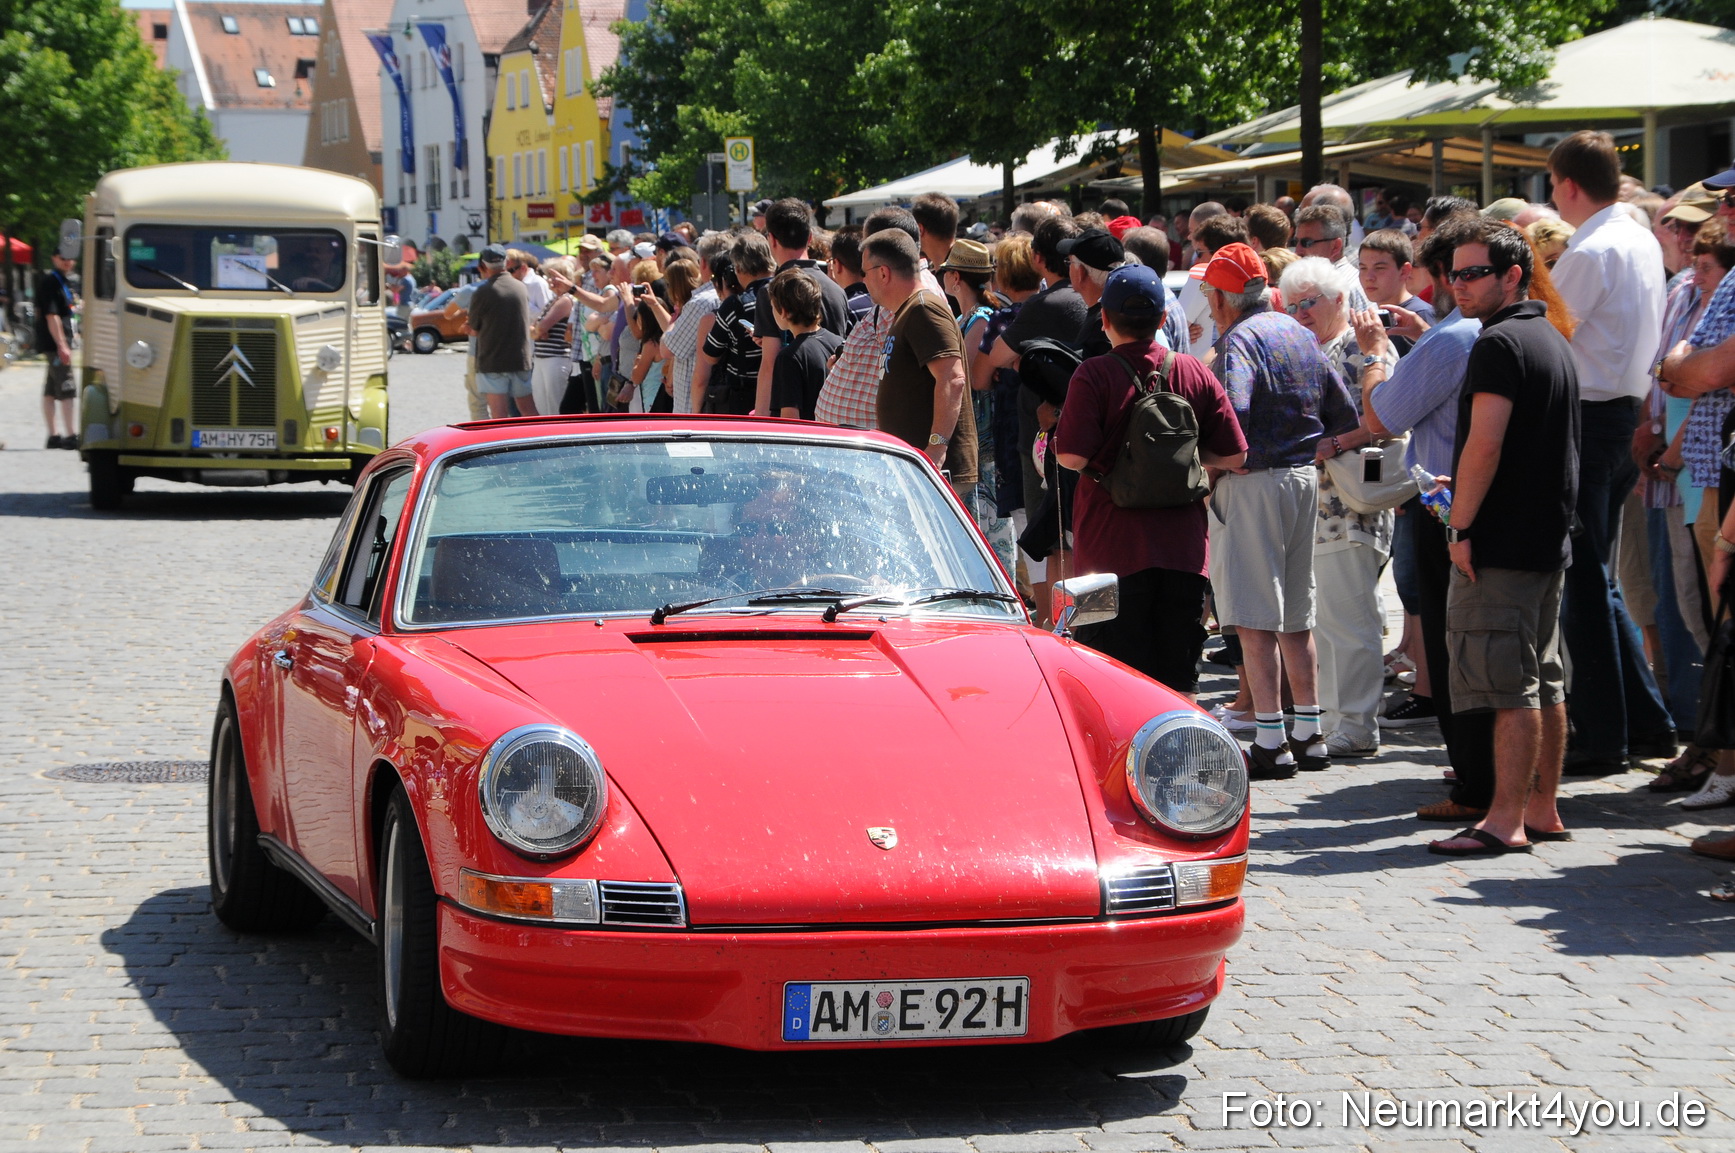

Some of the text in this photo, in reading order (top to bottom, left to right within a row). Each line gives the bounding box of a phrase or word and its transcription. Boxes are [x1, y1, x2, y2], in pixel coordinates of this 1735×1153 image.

[201, 433, 276, 447] AM HY 75H
[812, 990, 870, 1032] AM
[899, 989, 925, 1031] E
[792, 1017, 802, 1030] D
